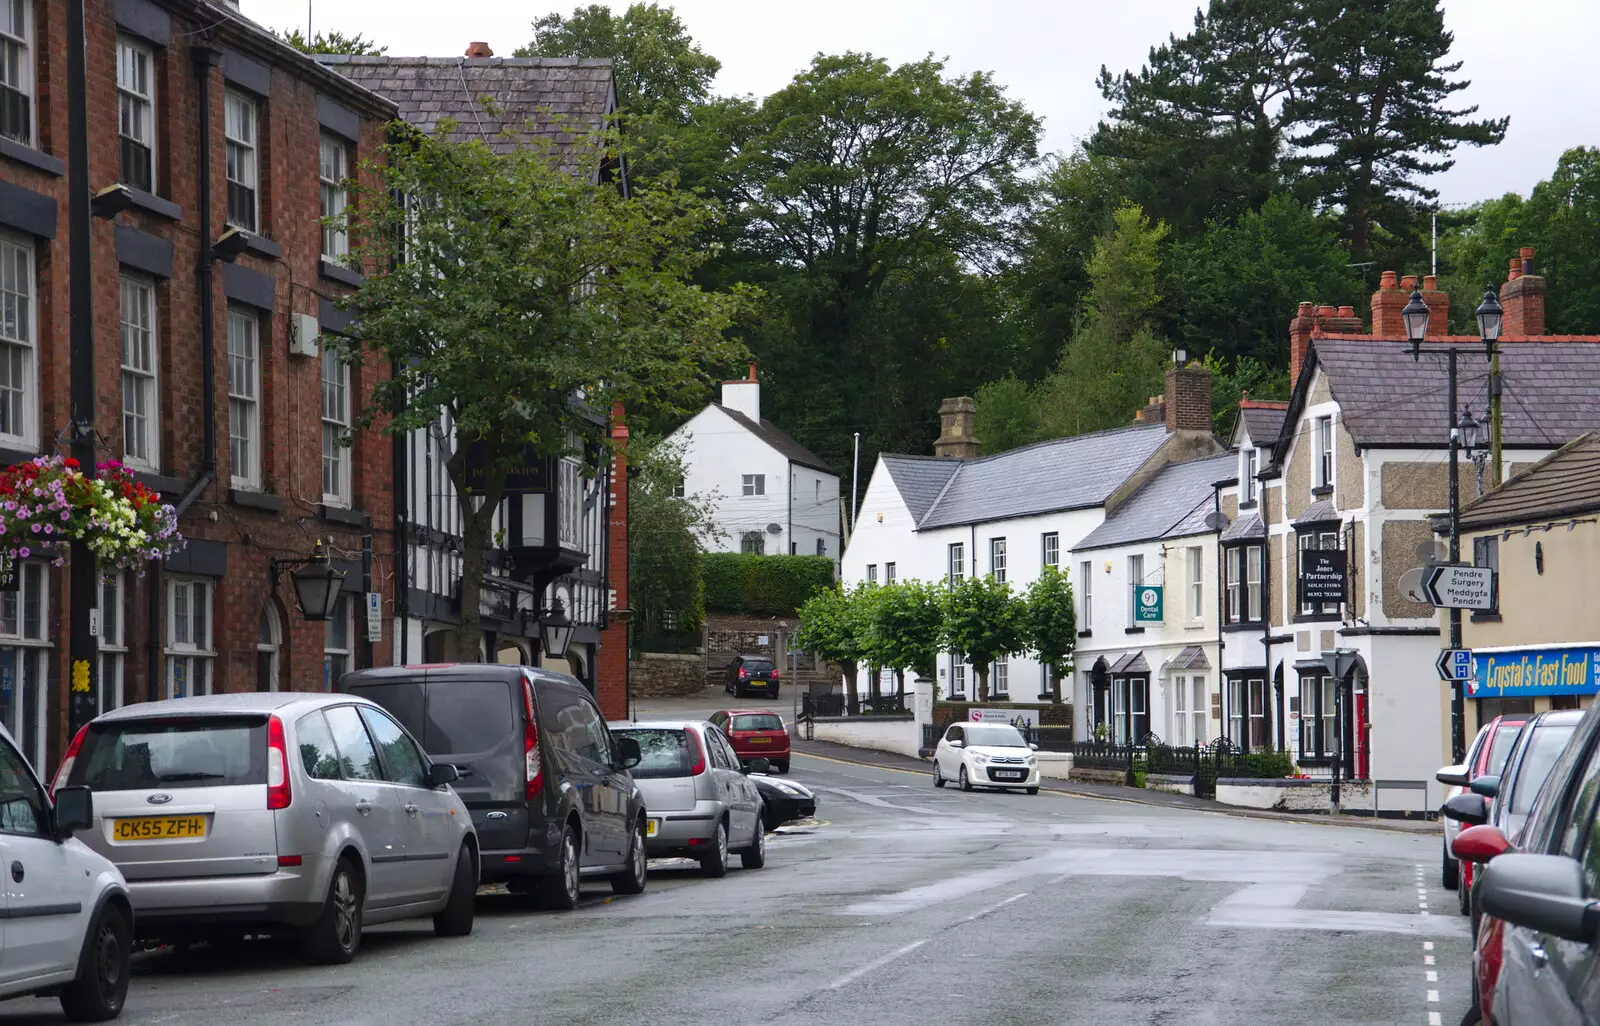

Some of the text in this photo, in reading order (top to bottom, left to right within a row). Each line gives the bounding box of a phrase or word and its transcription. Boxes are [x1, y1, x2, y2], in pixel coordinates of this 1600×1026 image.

[1306, 572, 1342, 581] Partnership
[1453, 569, 1483, 578] Pendre
[1451, 578, 1484, 587] Surgery
[1144, 592, 1155, 603] 91
[1447, 588, 1488, 598] Meddygfa
[1452, 596, 1482, 605] Pendre
[1456, 653, 1464, 662] P
[1457, 667, 1466, 676] H
[1486, 653, 1588, 696] Crystal's Fast Food
[120, 819, 199, 838] CK55 ZFH
